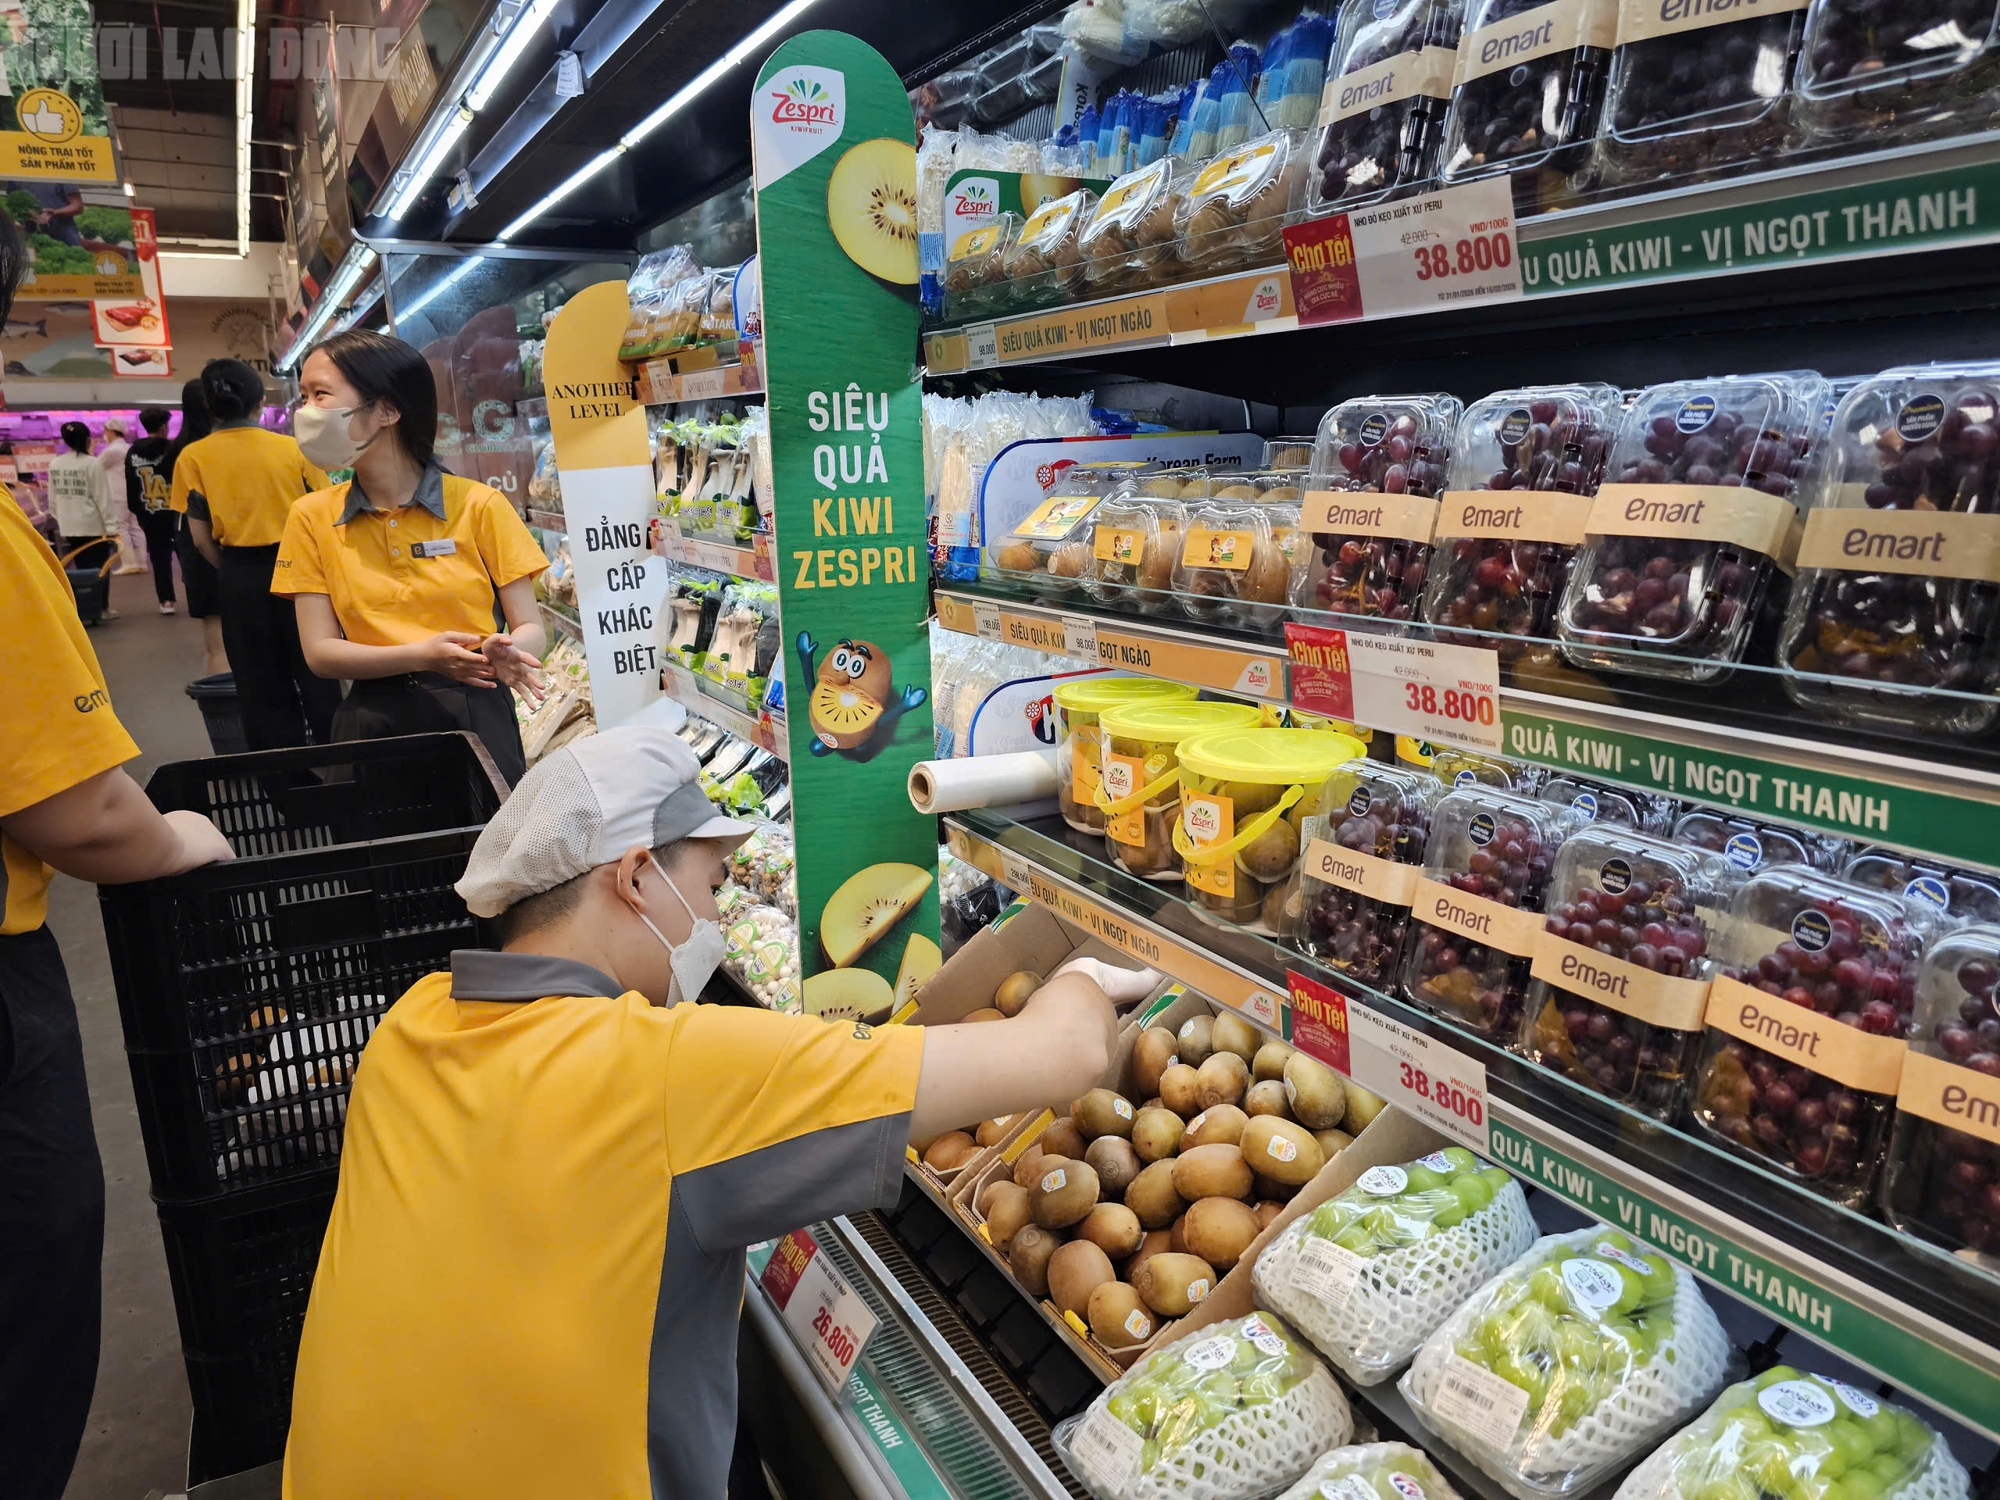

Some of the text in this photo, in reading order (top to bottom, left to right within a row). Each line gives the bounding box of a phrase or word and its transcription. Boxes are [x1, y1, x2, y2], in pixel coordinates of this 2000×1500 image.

[1481, 19, 1553, 64] emart
[1340, 71, 1396, 110] emart
[771, 92, 838, 126] Zespri
[791, 124, 823, 135] KIWIFRUIT
[18, 144, 94, 159] NÔNG TRẠI TỐT
[20, 157, 96, 172] SẢN PHẨM TỐT
[955, 196, 994, 216] Zespri
[1354, 199, 1443, 228] NHO ĐỎ KẸO XUẤT XỨ PERU
[1470, 217, 1509, 234] VND/100G
[1549, 187, 1976, 286] QUẢ KIWI VỊ NGỌT THANH
[1294, 232, 1352, 274] Chợ Tết
[1414, 233, 1511, 281] 38.800
[1256, 293, 1279, 309] Zespri
[1002, 304, 1152, 354] SIÊU QUẢ KIWI VỊ NGỌT NGÀO
[569, 402, 625, 421] LEVEL
[808, 382, 889, 432] SIÊU
[813, 433, 889, 491] QUẢ
[1205, 453, 1242, 467] Farm
[813, 497, 893, 536] KIWI
[1326, 505, 1383, 527] emart
[1462, 505, 1522, 528] emart
[1625, 498, 1705, 524] emart
[585, 514, 641, 552] ĐẲNG
[1843, 528, 1946, 561] emart
[606, 555, 646, 593] CẤP
[793, 545, 916, 589] ZESPRI
[597, 600, 653, 635] KHÁC
[613, 645, 656, 675] BIỆT
[1010, 622, 1030, 642] SIÊU
[1030, 626, 1049, 647] QUẢ
[1122, 641, 1151, 667] NGÀO
[1293, 641, 1347, 674] Chợ Tết
[1351, 638, 1434, 658] NHO ĐỎ KẸO XUẤT XỨ PERU
[1248, 671, 1268, 684] Zespri
[1458, 679, 1494, 693] VND/100G
[1405, 682, 1494, 726] 38.800
[1108, 771, 1129, 788] Zespri
[1511, 723, 1889, 832] QUẢ KIWI VỊ NGỌT THANH
[1191, 811, 1215, 830] Zespri
[1321, 854, 1365, 886] emart
[1042, 886, 1160, 962] QUẢ KIWI VỊ NGỌT NGÀO
[1435, 897, 1492, 936] emart
[1560, 954, 1630, 999] emart
[1294, 988, 1346, 1033] Chợ Tết
[1412, 1034, 1428, 1050] PERU
[1739, 1004, 1821, 1058] emart
[1400, 1061, 1483, 1127] 38.800
[1450, 1076, 1482, 1099] VND/100G
[1491, 1130, 1833, 1333] QUẢ KIWI VỊ NGỌT THANH
[812, 1307, 854, 1367] 26.800
[862, 1403, 903, 1449] THANH
